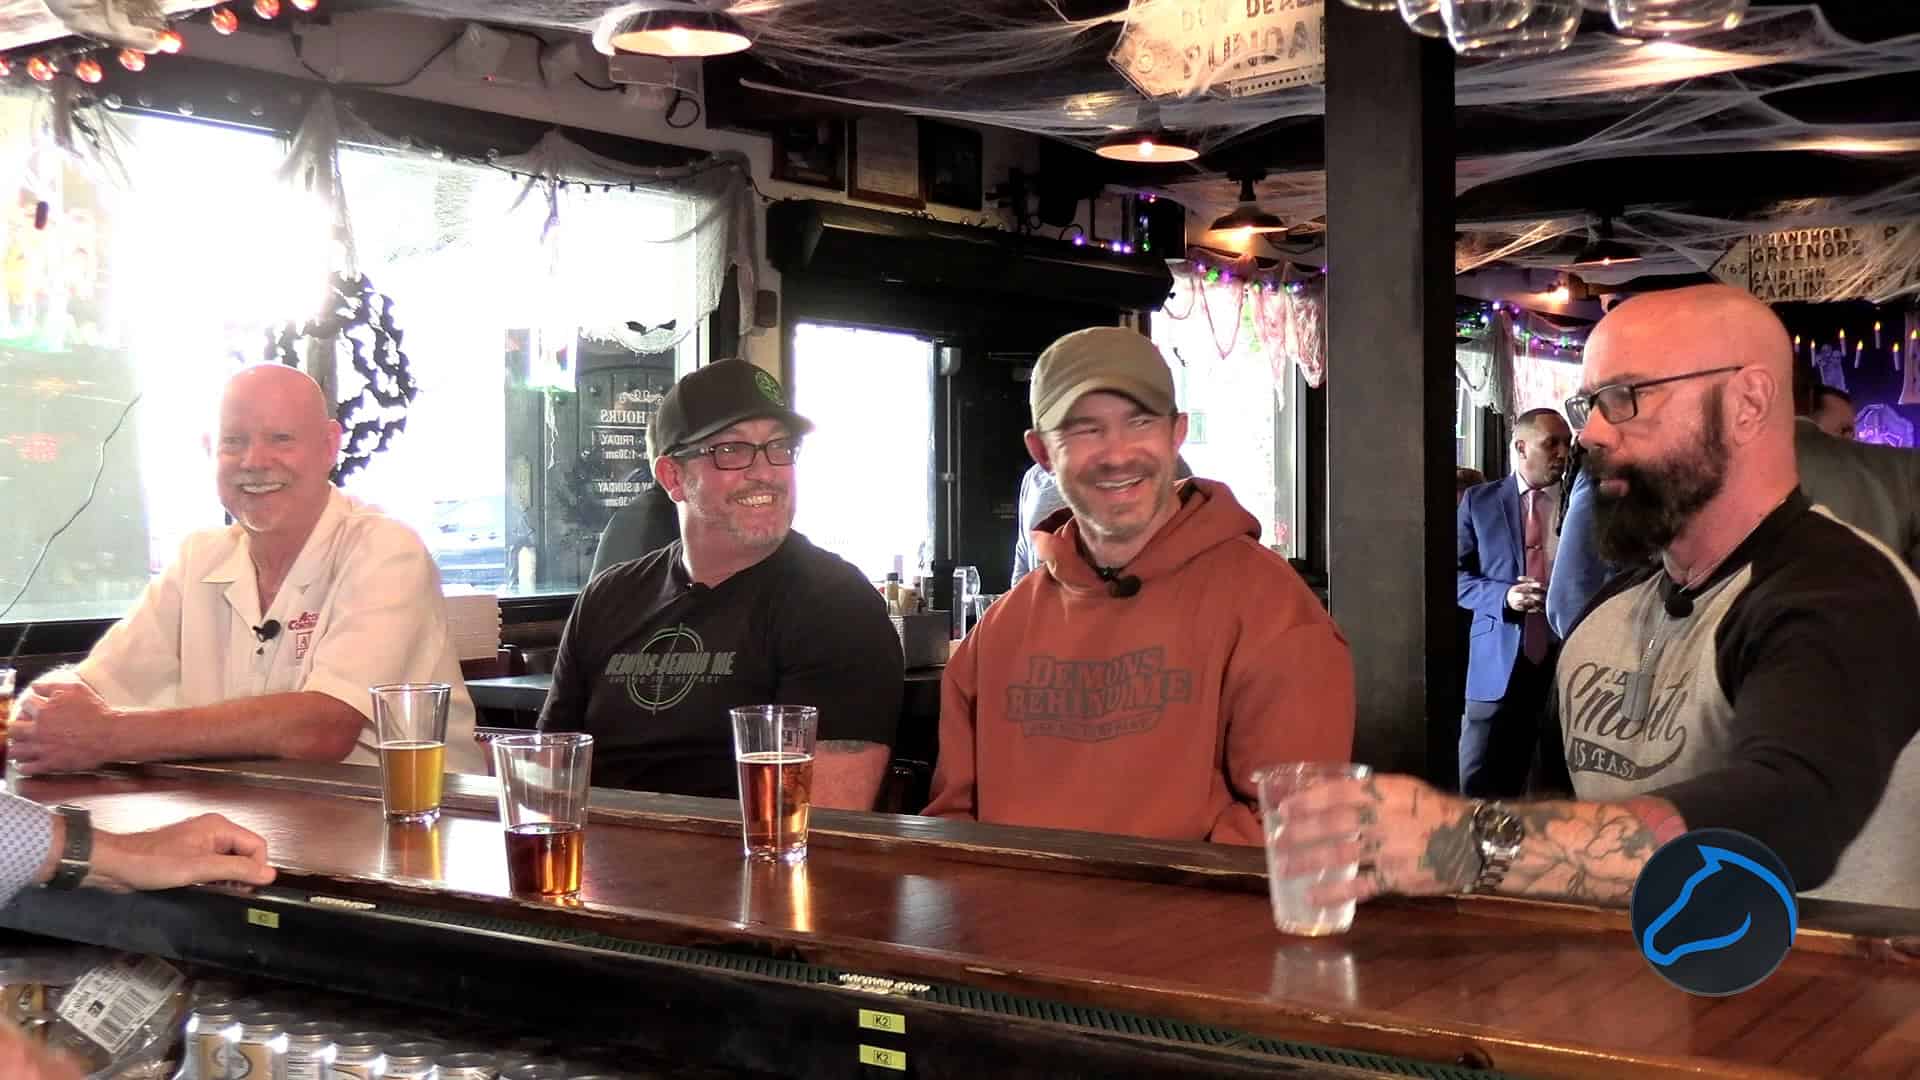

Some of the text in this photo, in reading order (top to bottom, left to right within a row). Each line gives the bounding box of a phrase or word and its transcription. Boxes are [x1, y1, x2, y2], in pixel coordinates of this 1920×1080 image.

[1752, 240, 1863, 264] GREENORE
[1029, 645, 1165, 690] DEMONS
[1007, 684, 1122, 721] BEHIND
[1591, 748, 1637, 778] FAST
